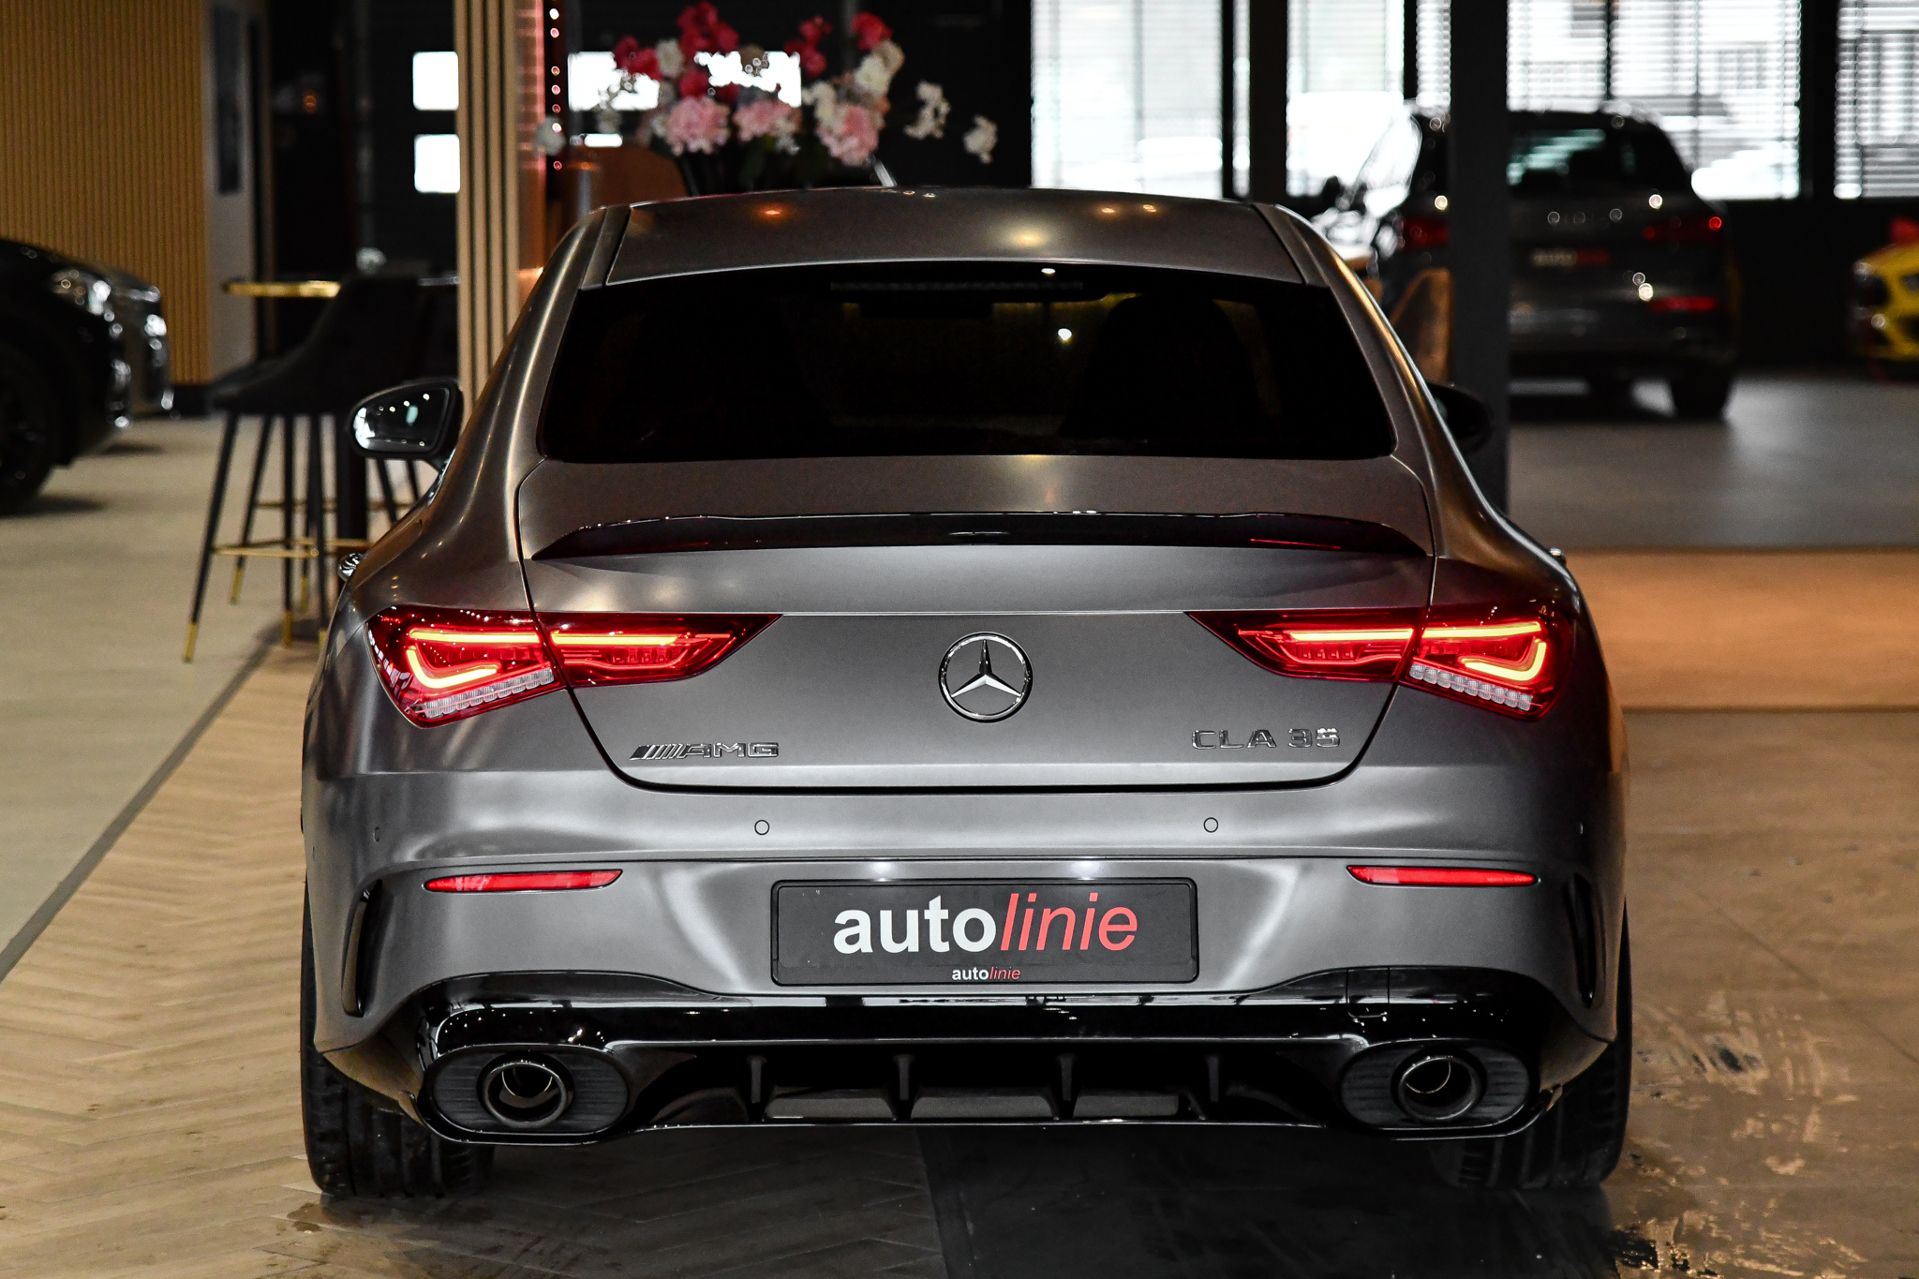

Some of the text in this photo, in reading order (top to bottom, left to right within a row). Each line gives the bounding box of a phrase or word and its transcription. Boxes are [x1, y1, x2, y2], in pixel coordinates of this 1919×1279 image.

[1192, 728, 1341, 750] CLA 35
[677, 742, 779, 759] AMG
[833, 892, 1138, 954] autolinie
[951, 966, 1021, 980] autolinie
